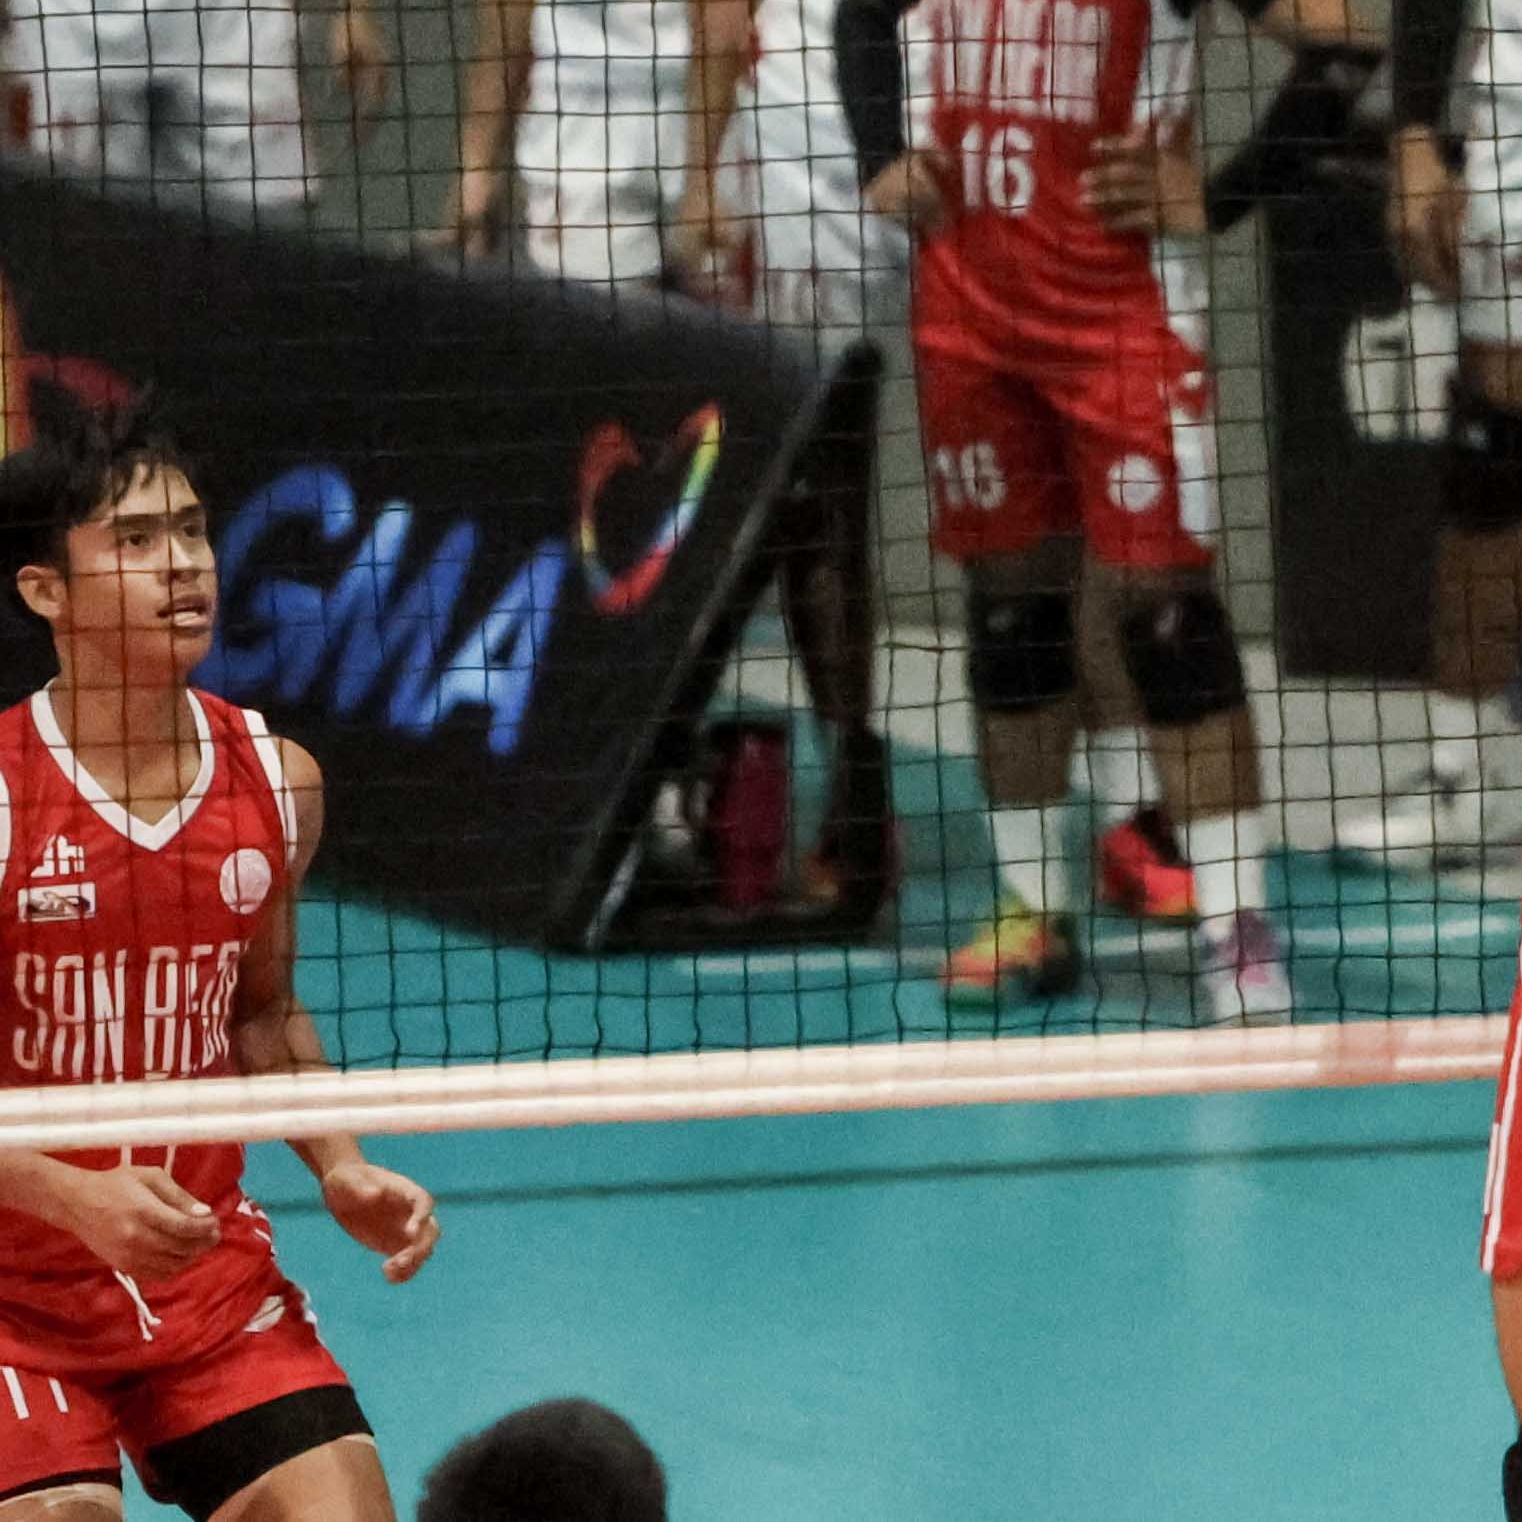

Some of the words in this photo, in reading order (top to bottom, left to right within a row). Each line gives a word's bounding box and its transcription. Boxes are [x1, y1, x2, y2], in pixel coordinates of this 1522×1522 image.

[960, 121, 1036, 226] 16
[192, 462, 570, 758] GMA
[13, 948, 128, 1083] SAN
